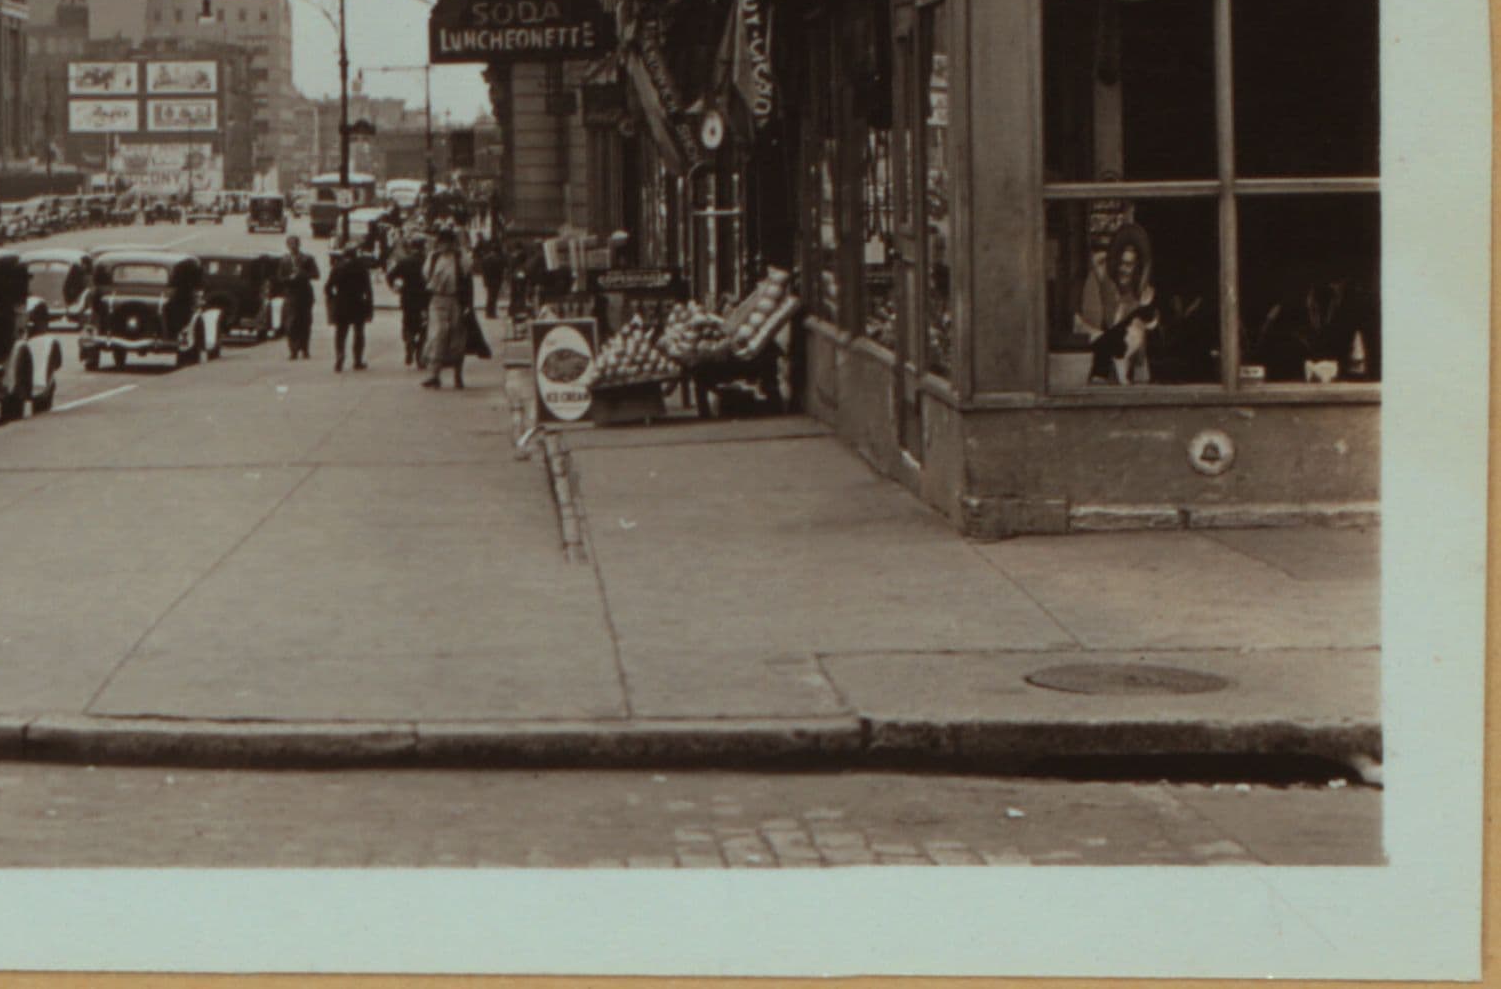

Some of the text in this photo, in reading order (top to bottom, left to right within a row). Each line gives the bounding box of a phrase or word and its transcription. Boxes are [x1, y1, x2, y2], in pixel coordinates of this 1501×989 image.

[472, 0, 561, 25] SODA
[439, 21, 596, 52] LUNCHEONETTE
[129, 170, 181, 185] OCONY
